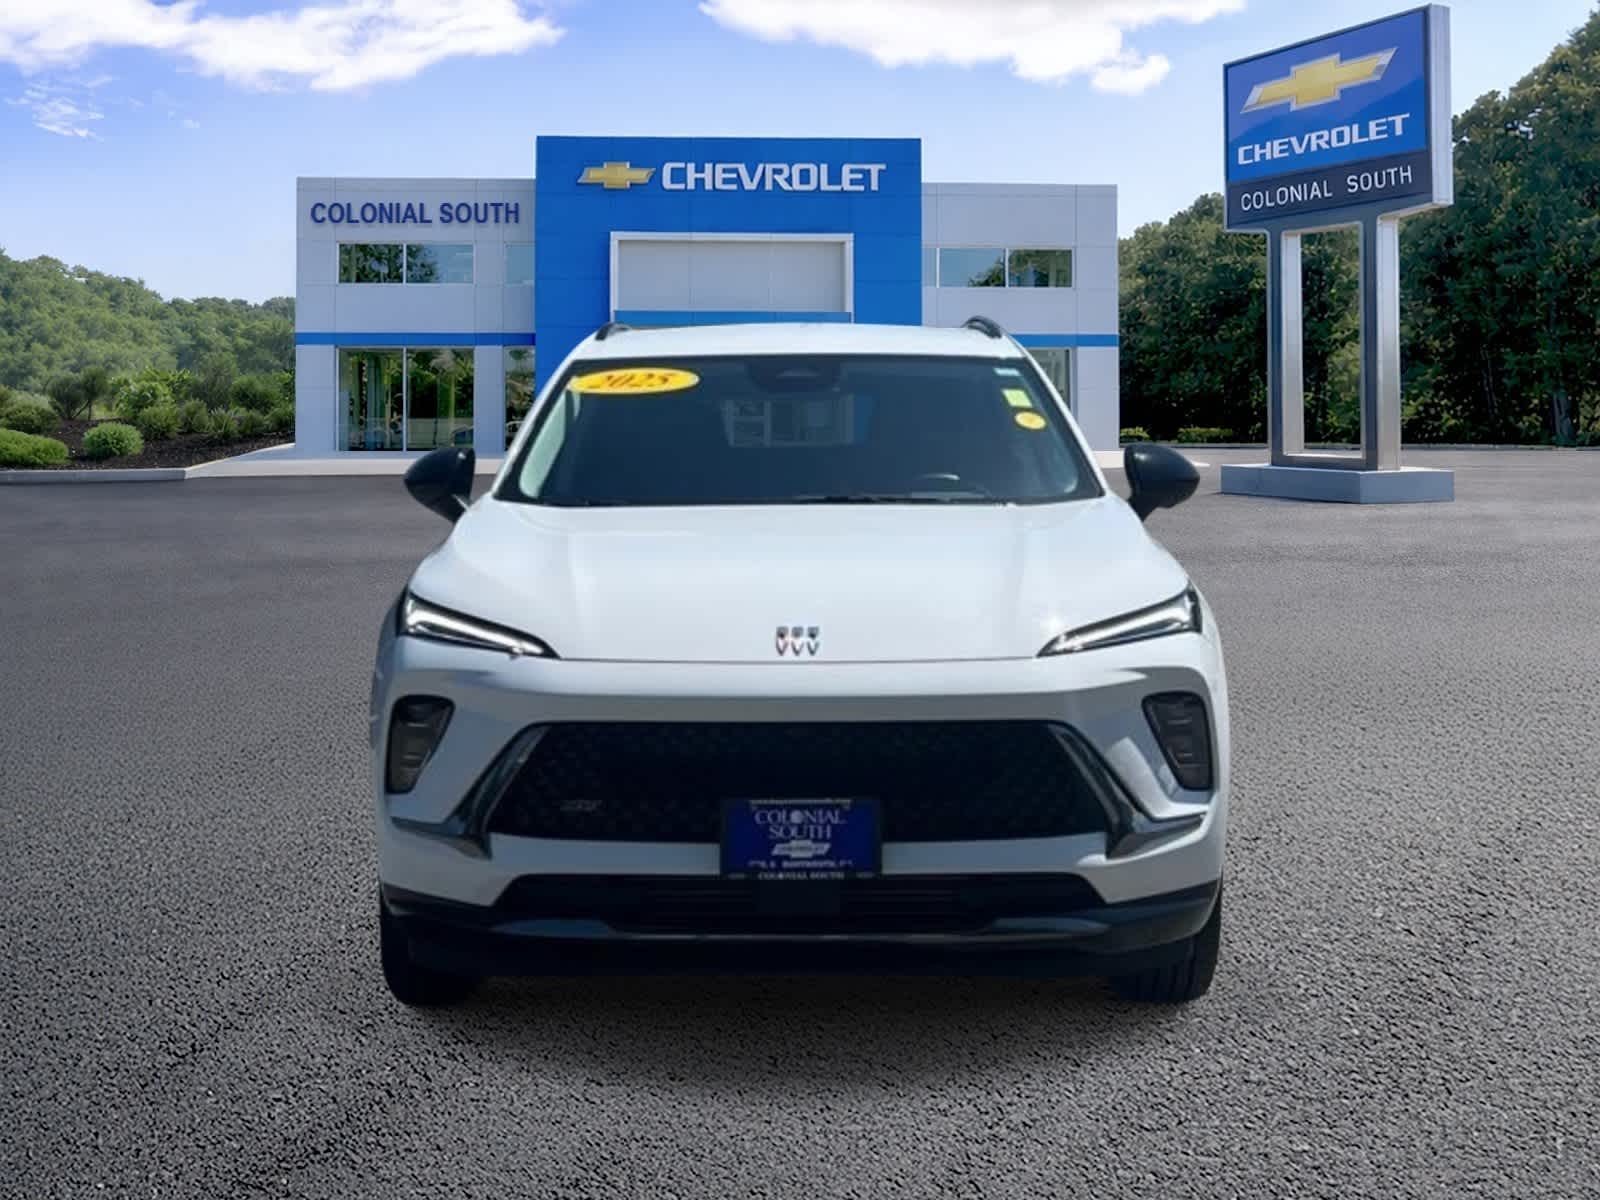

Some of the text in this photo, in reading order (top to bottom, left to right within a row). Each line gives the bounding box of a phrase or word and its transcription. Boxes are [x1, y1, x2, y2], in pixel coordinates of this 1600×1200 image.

[1237, 113, 1410, 165] CHEVROLET
[661, 162, 886, 192] CHEVROLET
[1240, 165, 1412, 211] COLONIAL SOUTH
[310, 202, 520, 225] COLONIAL SOUTH
[754, 809, 847, 824] COLONIAL
[768, 824, 832, 839] SOUTH
